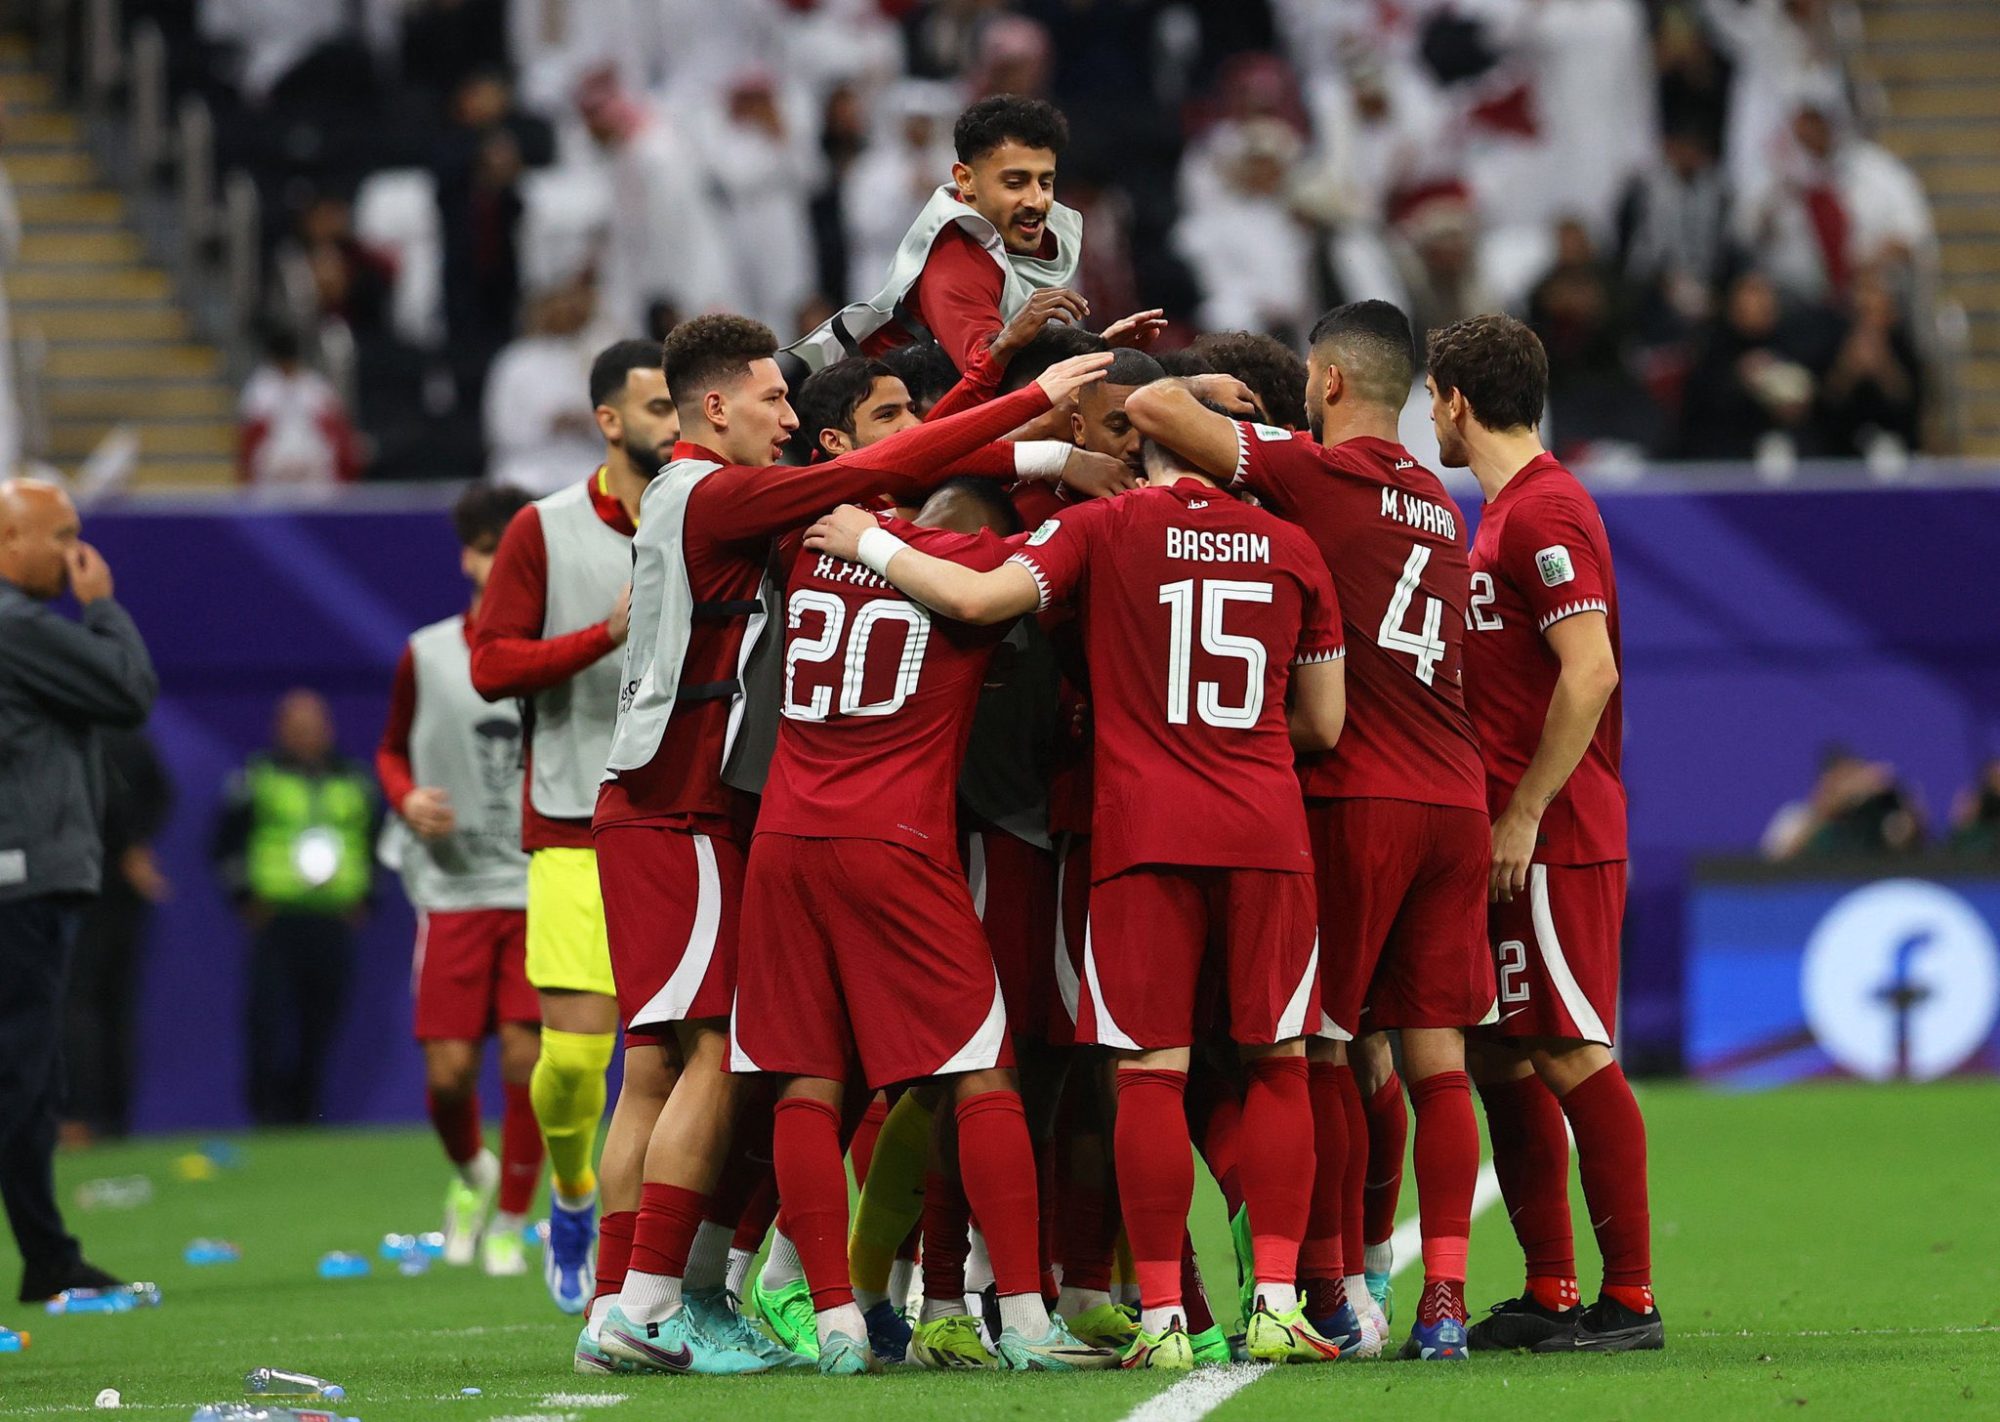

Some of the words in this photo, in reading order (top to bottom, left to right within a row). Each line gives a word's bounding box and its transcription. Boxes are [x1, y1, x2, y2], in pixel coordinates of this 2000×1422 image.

[1167, 526, 1270, 564] BASSAM
[1381, 486, 1456, 540] M.WAAD
[780, 589, 931, 722] 20
[1159, 578, 1273, 729] 15
[1377, 543, 1446, 687] 4
